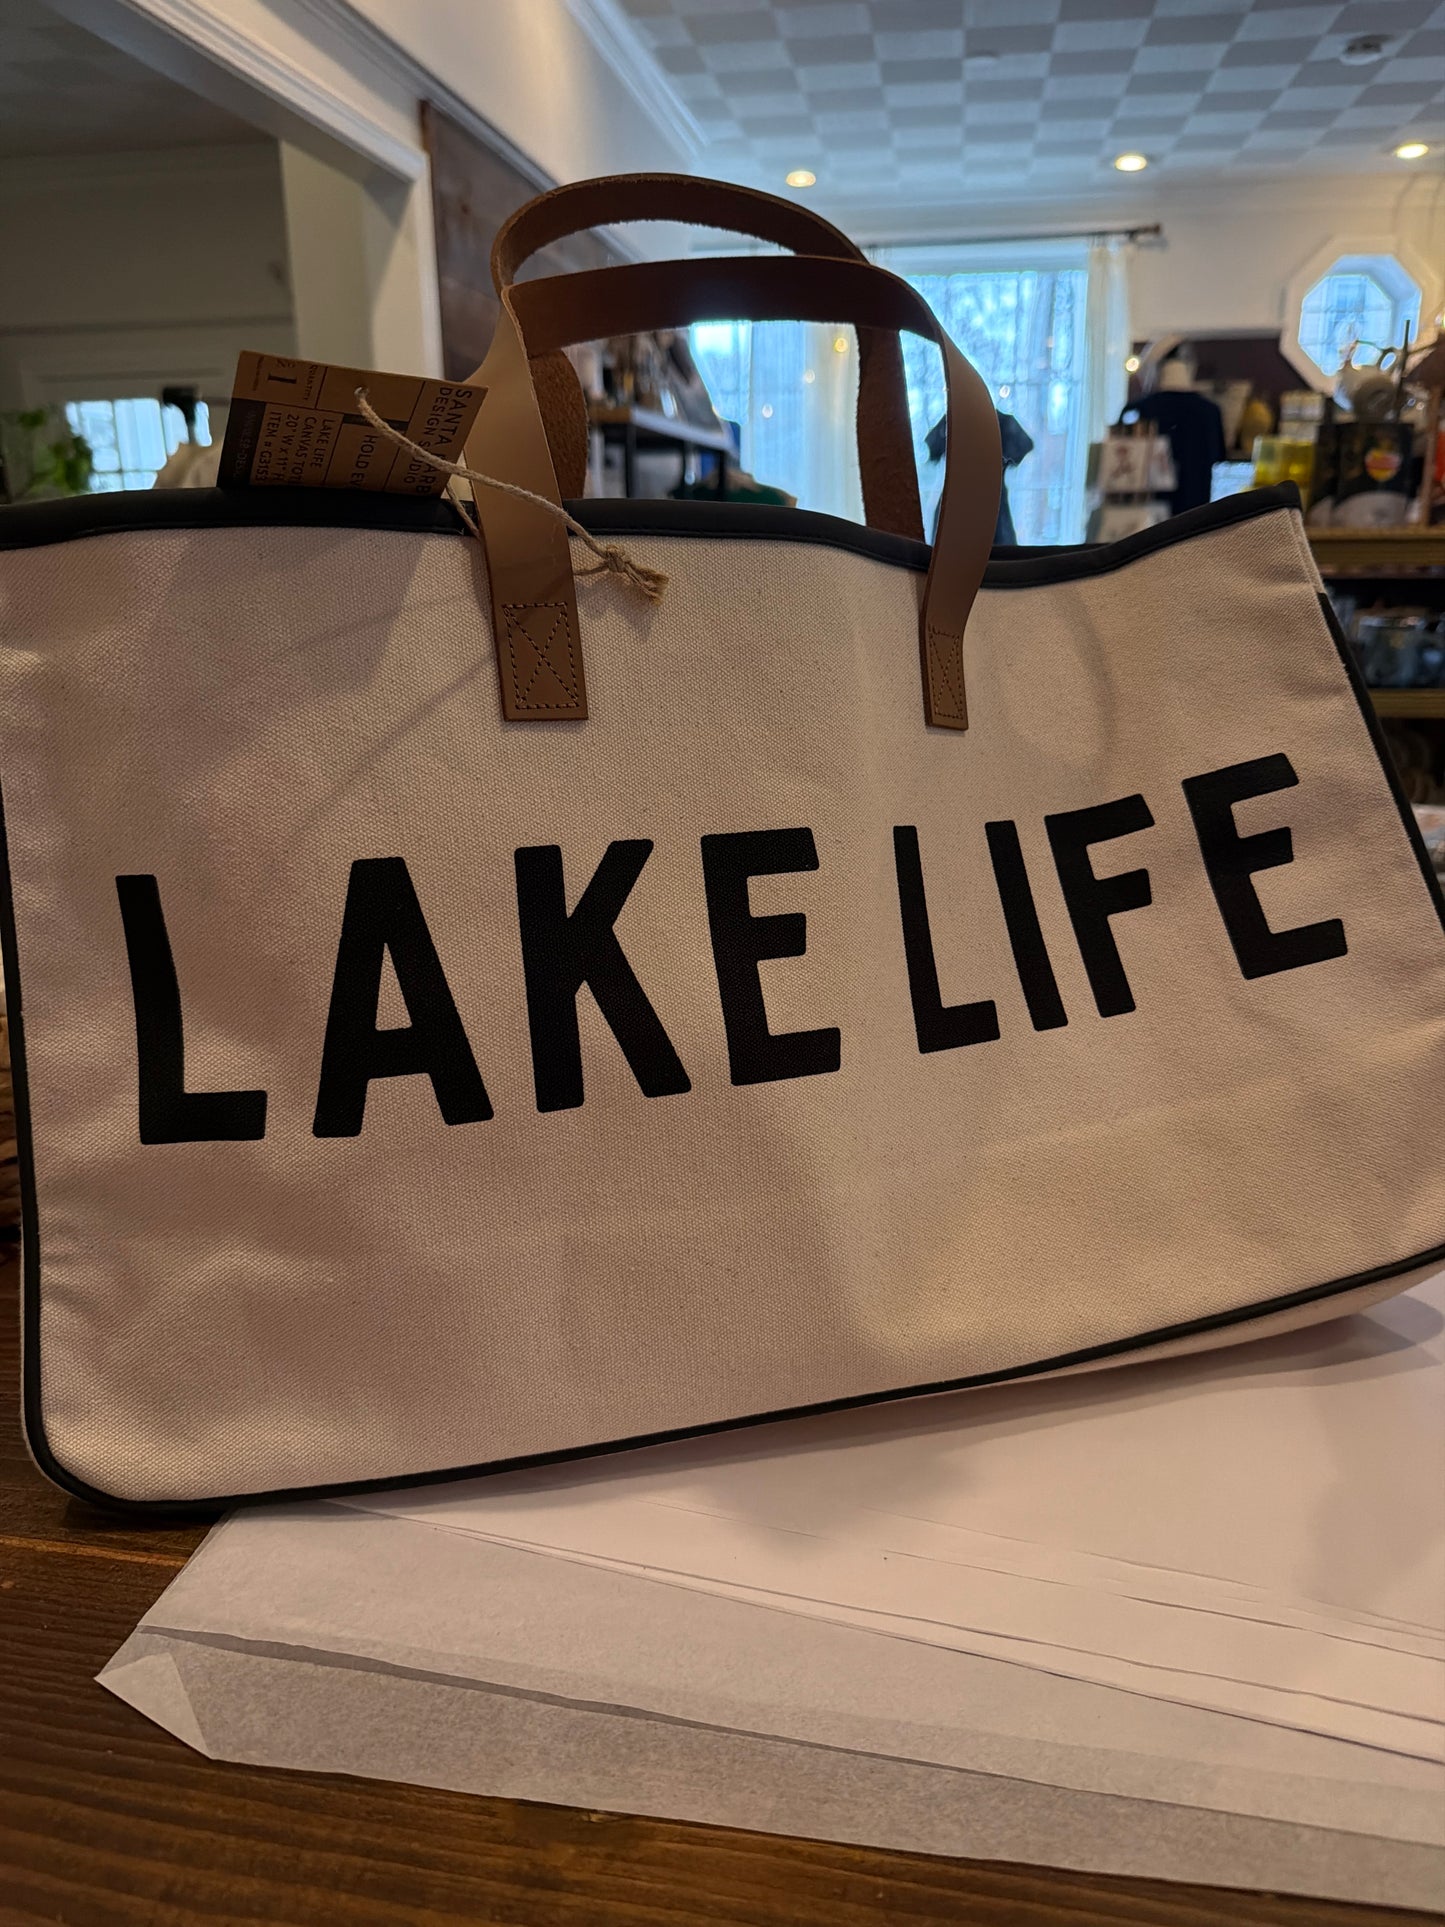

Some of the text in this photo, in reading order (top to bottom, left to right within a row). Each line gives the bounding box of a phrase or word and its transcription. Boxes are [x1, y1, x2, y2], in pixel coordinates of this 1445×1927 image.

[265, 411, 283, 438] ITEM
[403, 387, 452, 484] DESIGN SUDIO
[435, 389, 473, 446] SANTA
[282, 434, 294, 446] W
[295, 416, 318, 459] CANVAS
[309, 418, 337, 469] LAKE LIFE
[356, 434, 379, 469] HOLD
[254, 450, 273, 482] G3153
[347, 472, 364, 489] EV
[115, 752, 1349, 1145] LAKE LIFE
